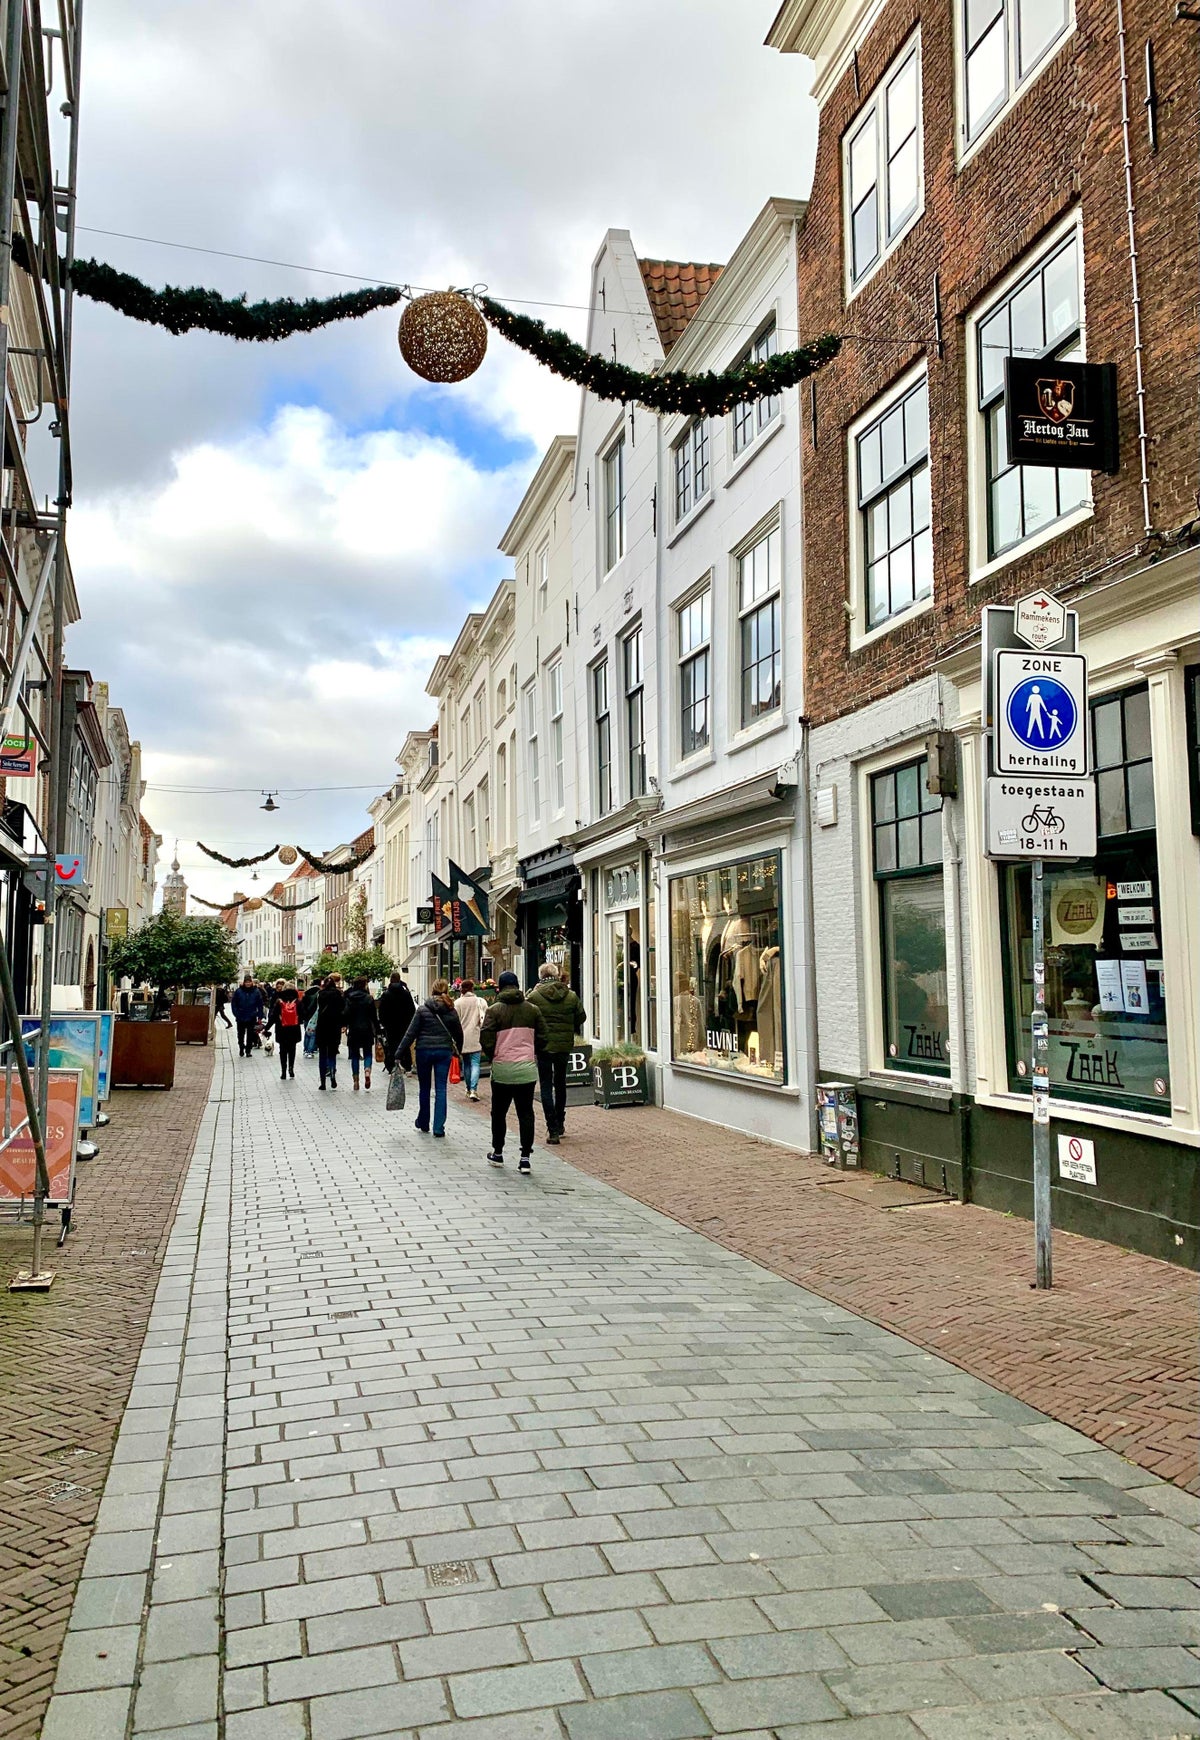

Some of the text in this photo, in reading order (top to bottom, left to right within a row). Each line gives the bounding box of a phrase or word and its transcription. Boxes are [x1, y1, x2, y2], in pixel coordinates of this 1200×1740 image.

[1023, 419, 1089, 440] Hertog Jan
[1021, 611, 1060, 623] Rammekens
[1022, 660, 1062, 672] ZONE
[1009, 754, 1076, 770] herhaling
[1001, 784, 1084, 799] toegestaan
[1020, 838, 1067, 850] 18-11 h
[1121, 883, 1146, 894] WELKOM
[453, 901, 461, 932] SOFTIJS
[706, 1030, 739, 1052] ELVINE
